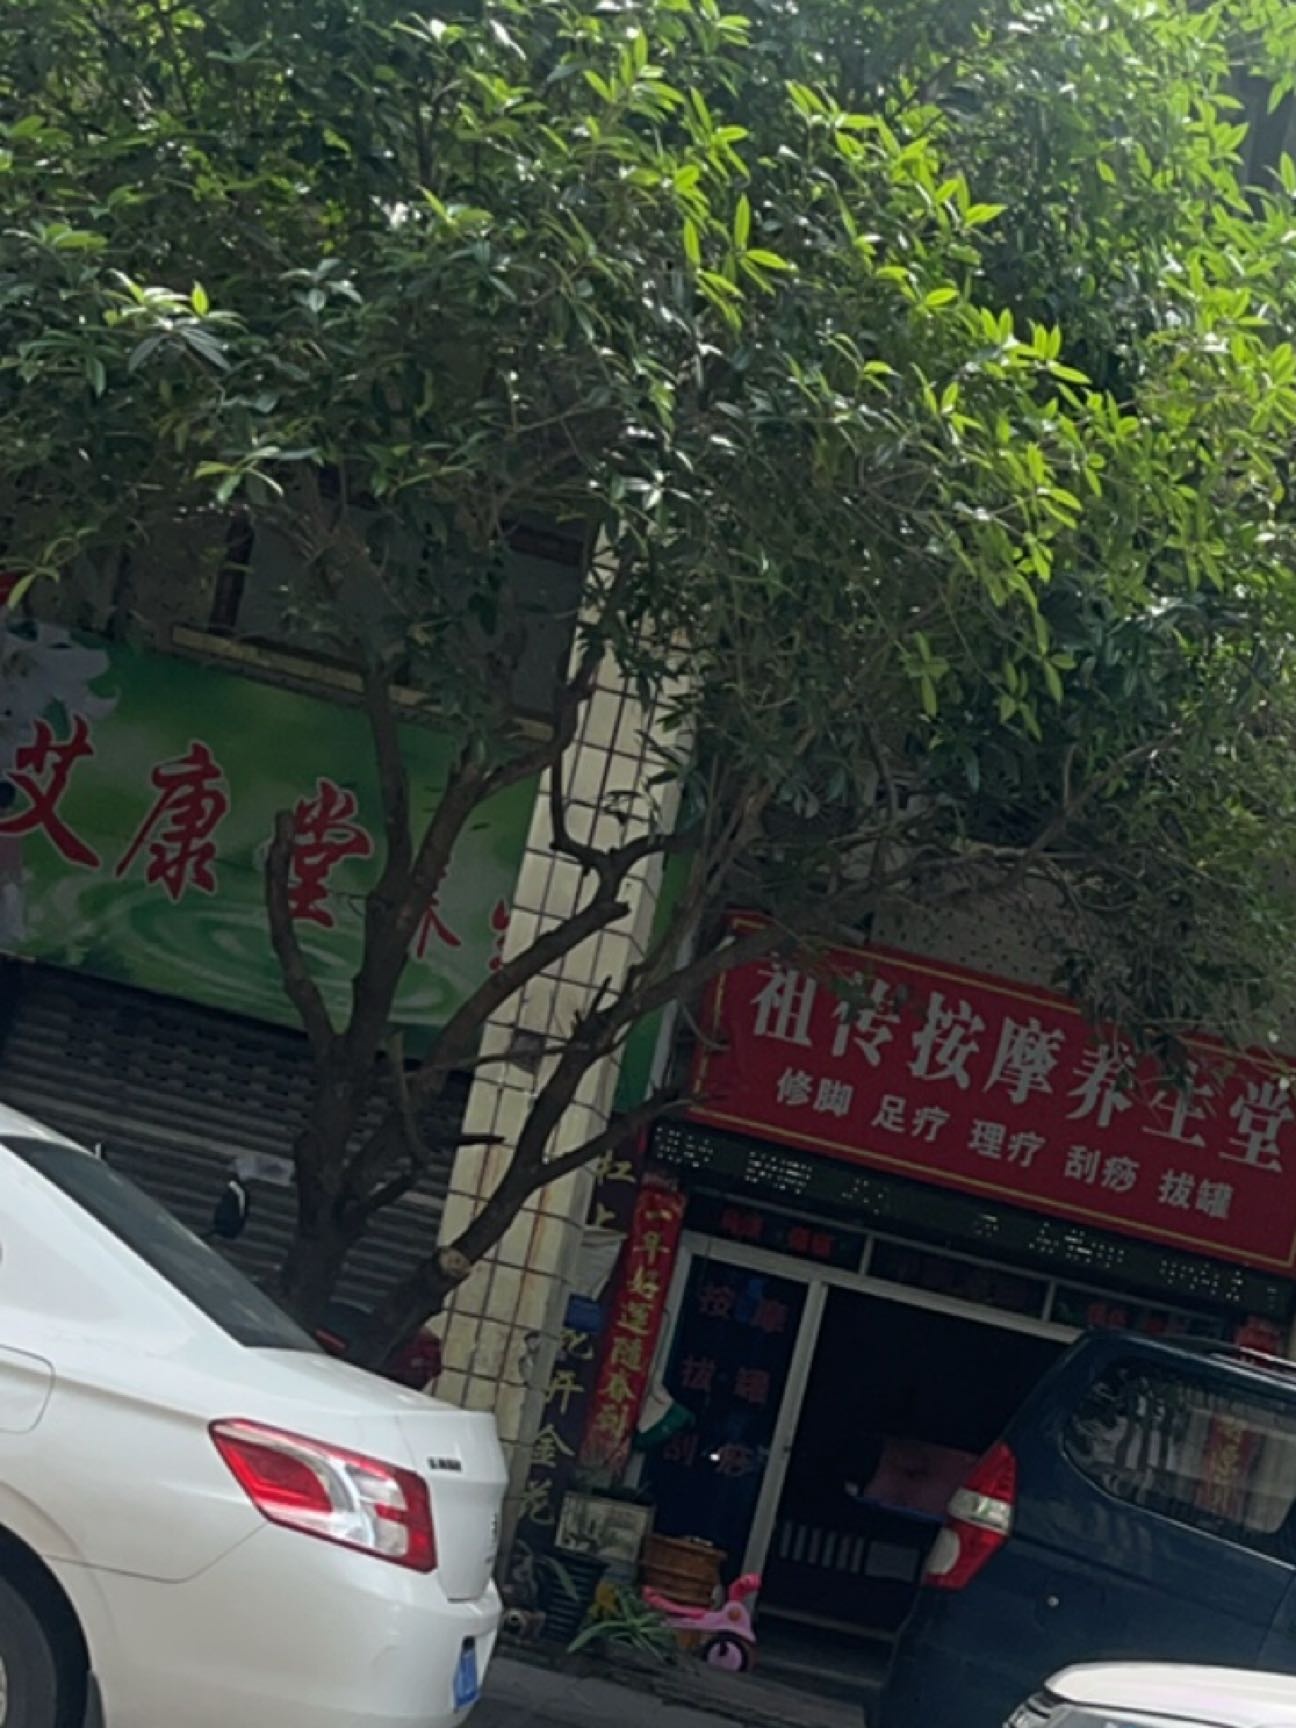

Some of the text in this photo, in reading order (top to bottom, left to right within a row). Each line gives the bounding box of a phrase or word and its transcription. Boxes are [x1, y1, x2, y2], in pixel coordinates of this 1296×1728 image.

[752, 966, 1296, 1174] 祖传按摩养生堂
[776, 1066, 1234, 1220] 修脚 足疗 理疗 刮痧 拔罐
